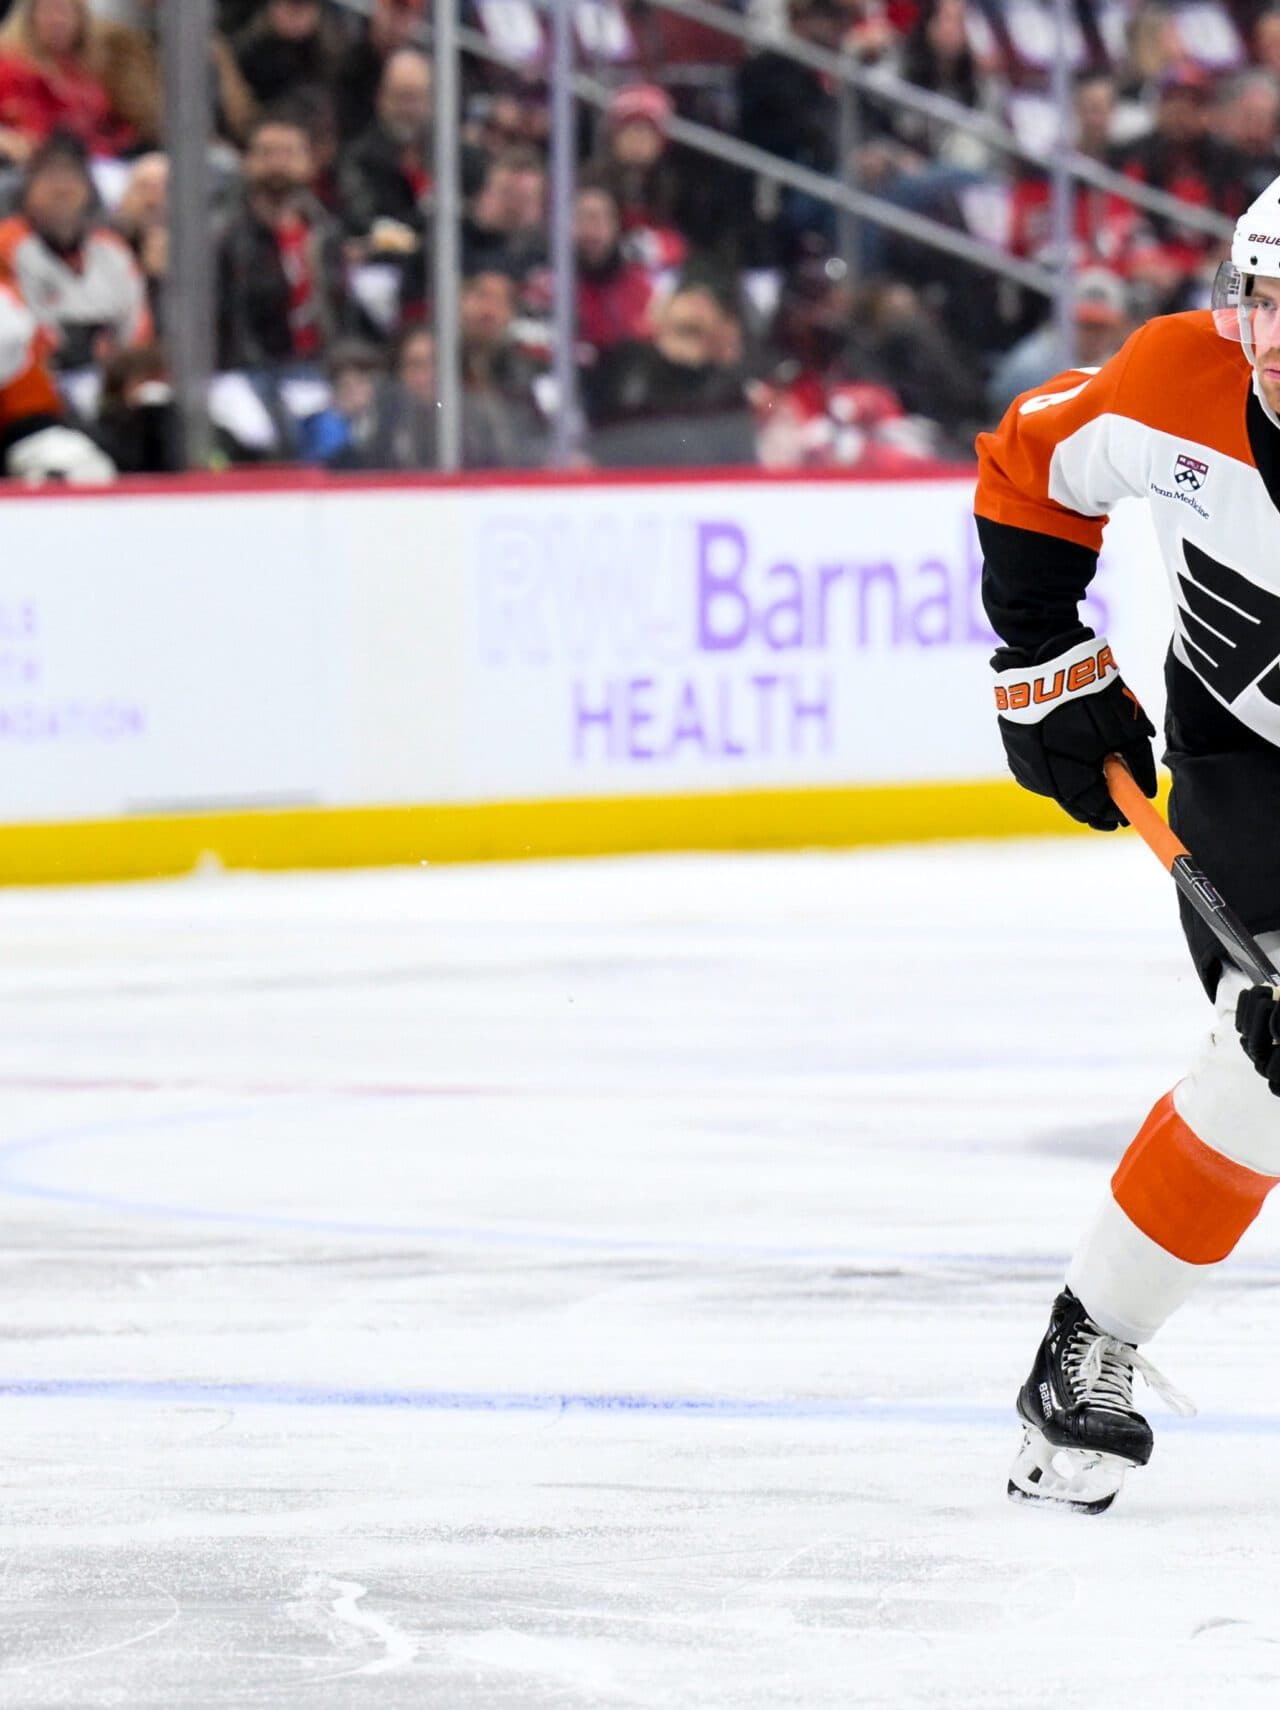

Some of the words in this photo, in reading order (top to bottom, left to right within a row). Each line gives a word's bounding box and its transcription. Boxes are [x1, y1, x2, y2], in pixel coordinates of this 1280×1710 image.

[1150, 483, 1173, 498] Penn
[1173, 491, 1210, 520] Medicine
[572, 671, 836, 766] HEALTH
